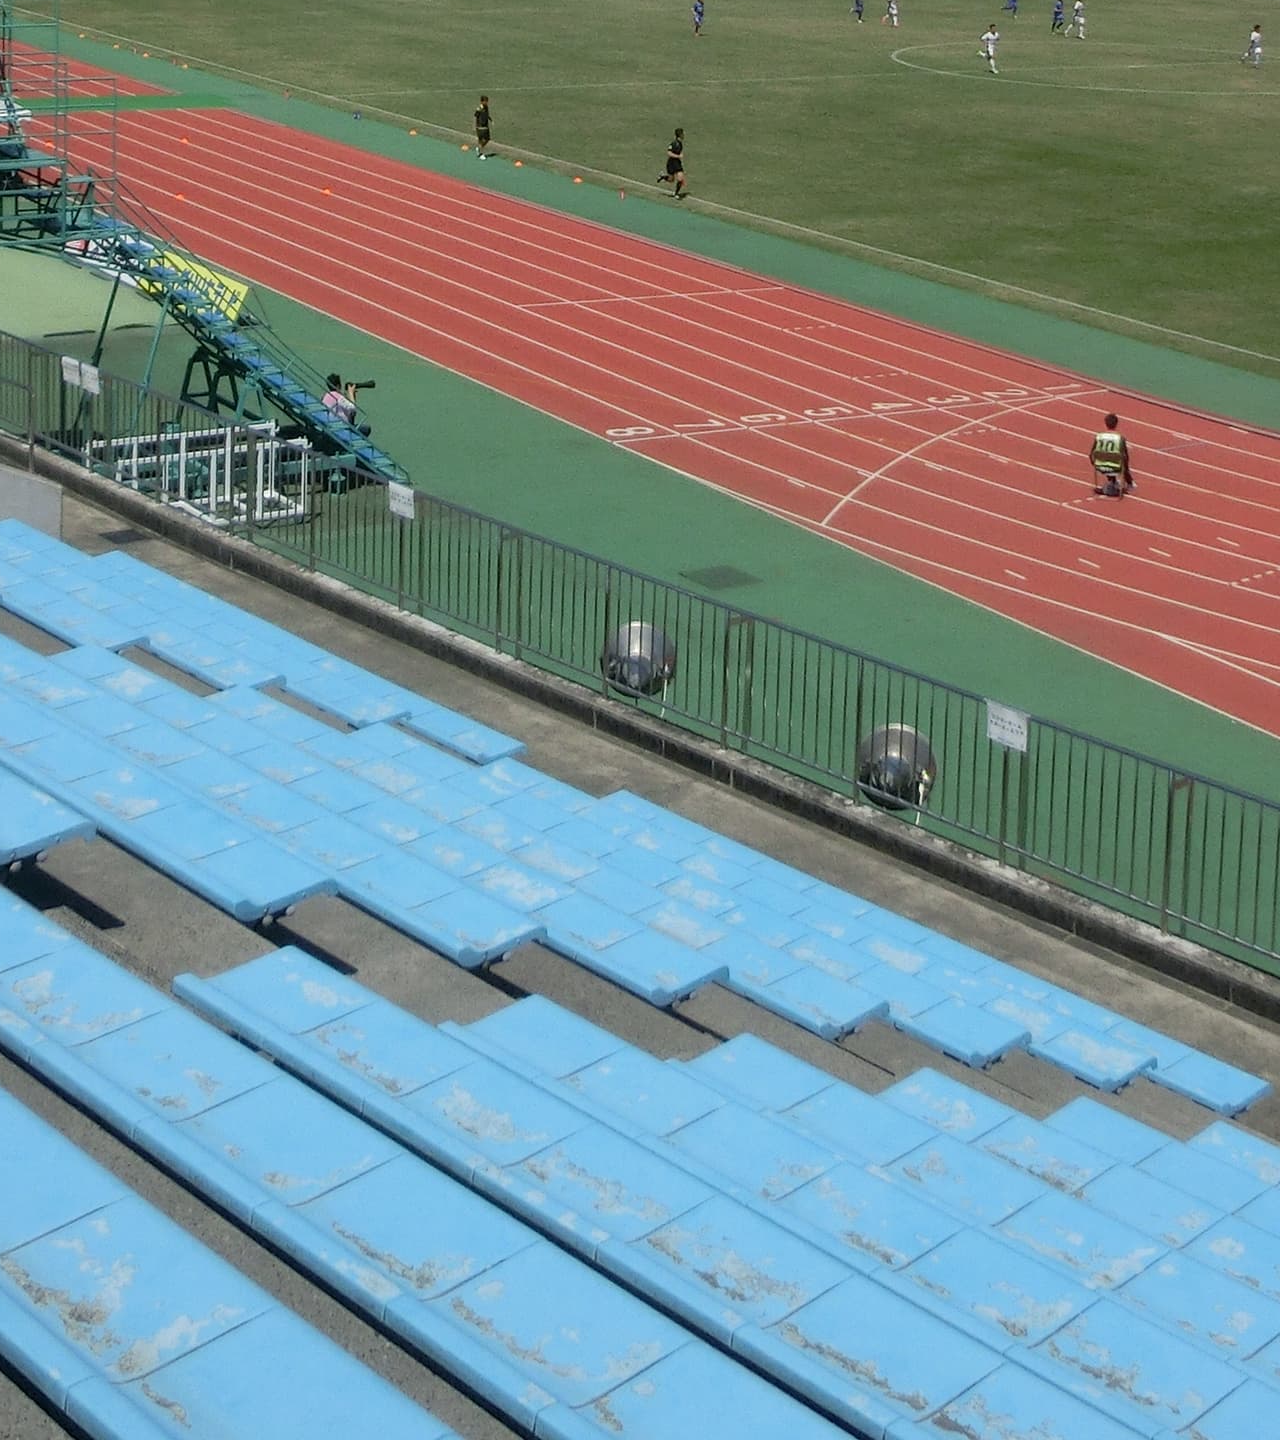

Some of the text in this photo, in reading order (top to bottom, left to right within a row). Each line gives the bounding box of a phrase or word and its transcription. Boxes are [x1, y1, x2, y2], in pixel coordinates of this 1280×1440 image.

[606, 426, 654, 440] 8
[675, 418, 726, 430] 7
[740, 412, 787, 426] 6
[804, 406, 852, 420] 5
[870, 400, 913, 412] 4
[927, 394, 972, 406] 3
[984, 388, 1030, 400] 2
